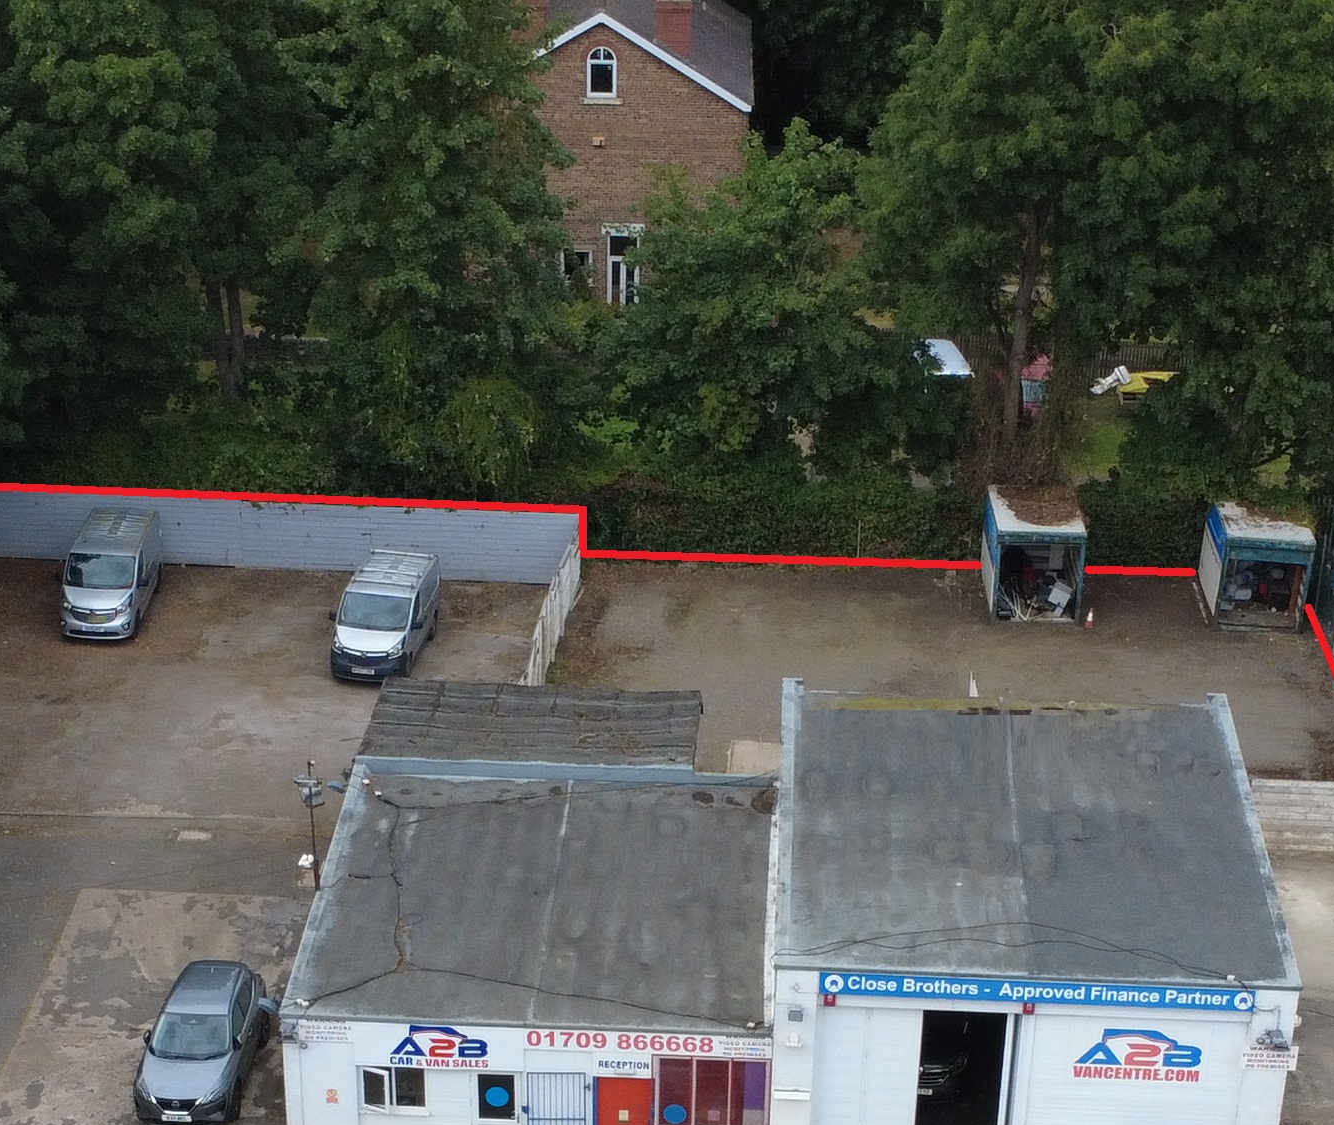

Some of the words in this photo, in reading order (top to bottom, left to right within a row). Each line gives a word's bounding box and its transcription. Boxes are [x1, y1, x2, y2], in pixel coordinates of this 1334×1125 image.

[847, 976, 897, 991] Close
[903, 978, 979, 995] Brothers
[999, 982, 1085, 1001] Approved
[1090, 986, 1159, 1003] Finance
[1165, 990, 1230, 1006] Partner
[390, 1034, 488, 1058] A2B
[526, 1030, 608, 1049] 01709
[617, 1034, 714, 1053] 866668
[389, 1056, 413, 1065] CAR
[425, 1058, 450, 1067] VAN
[452, 1059, 489, 1068] SALES
[598, 1060, 649, 1070] RECEPTION
[1074, 1040, 1202, 1068] A2B
[1073, 1065, 1200, 1082] VANCENTRE.COM
